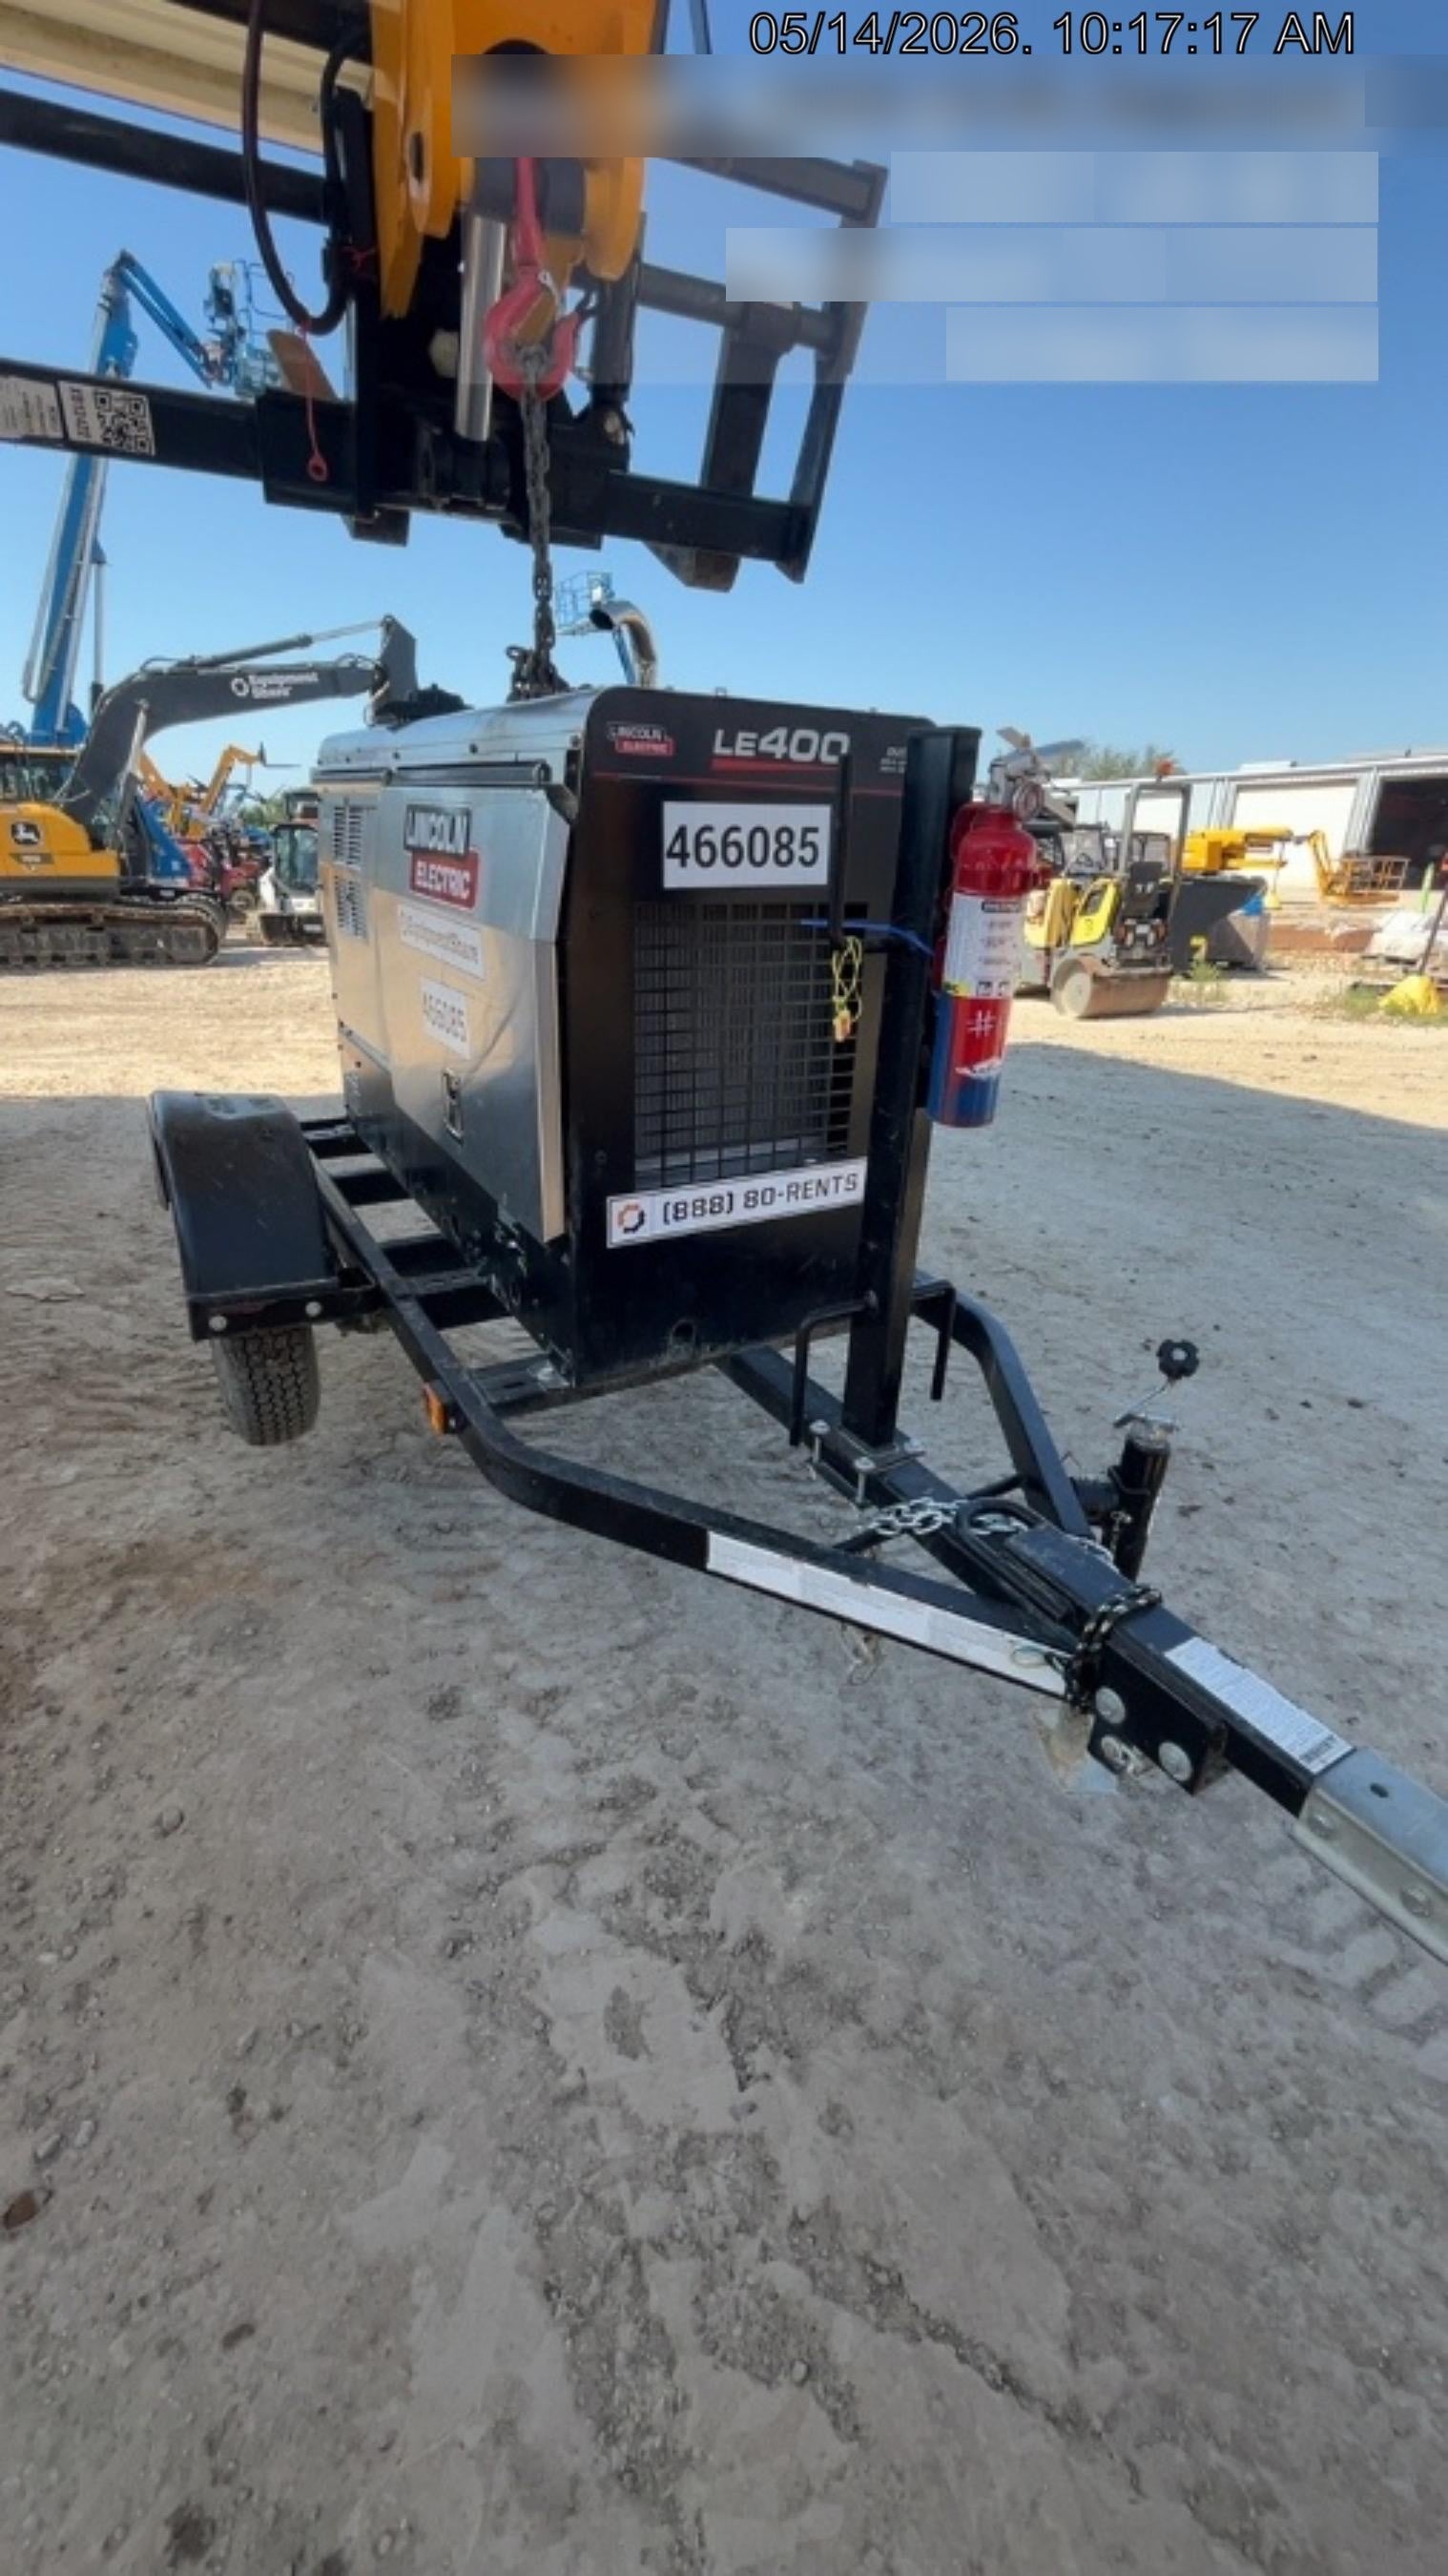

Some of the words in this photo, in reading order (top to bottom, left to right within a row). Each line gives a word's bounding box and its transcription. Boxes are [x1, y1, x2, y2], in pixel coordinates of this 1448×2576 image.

[713, 727, 850, 763] LE400
[405, 810, 467, 855] LINCOLN
[666, 824, 819, 868] 466085
[416, 860, 470, 901] ELECTRIC
[662, 1192, 734, 1225] (888)
[743, 1172, 858, 1209] 80-RENTS
